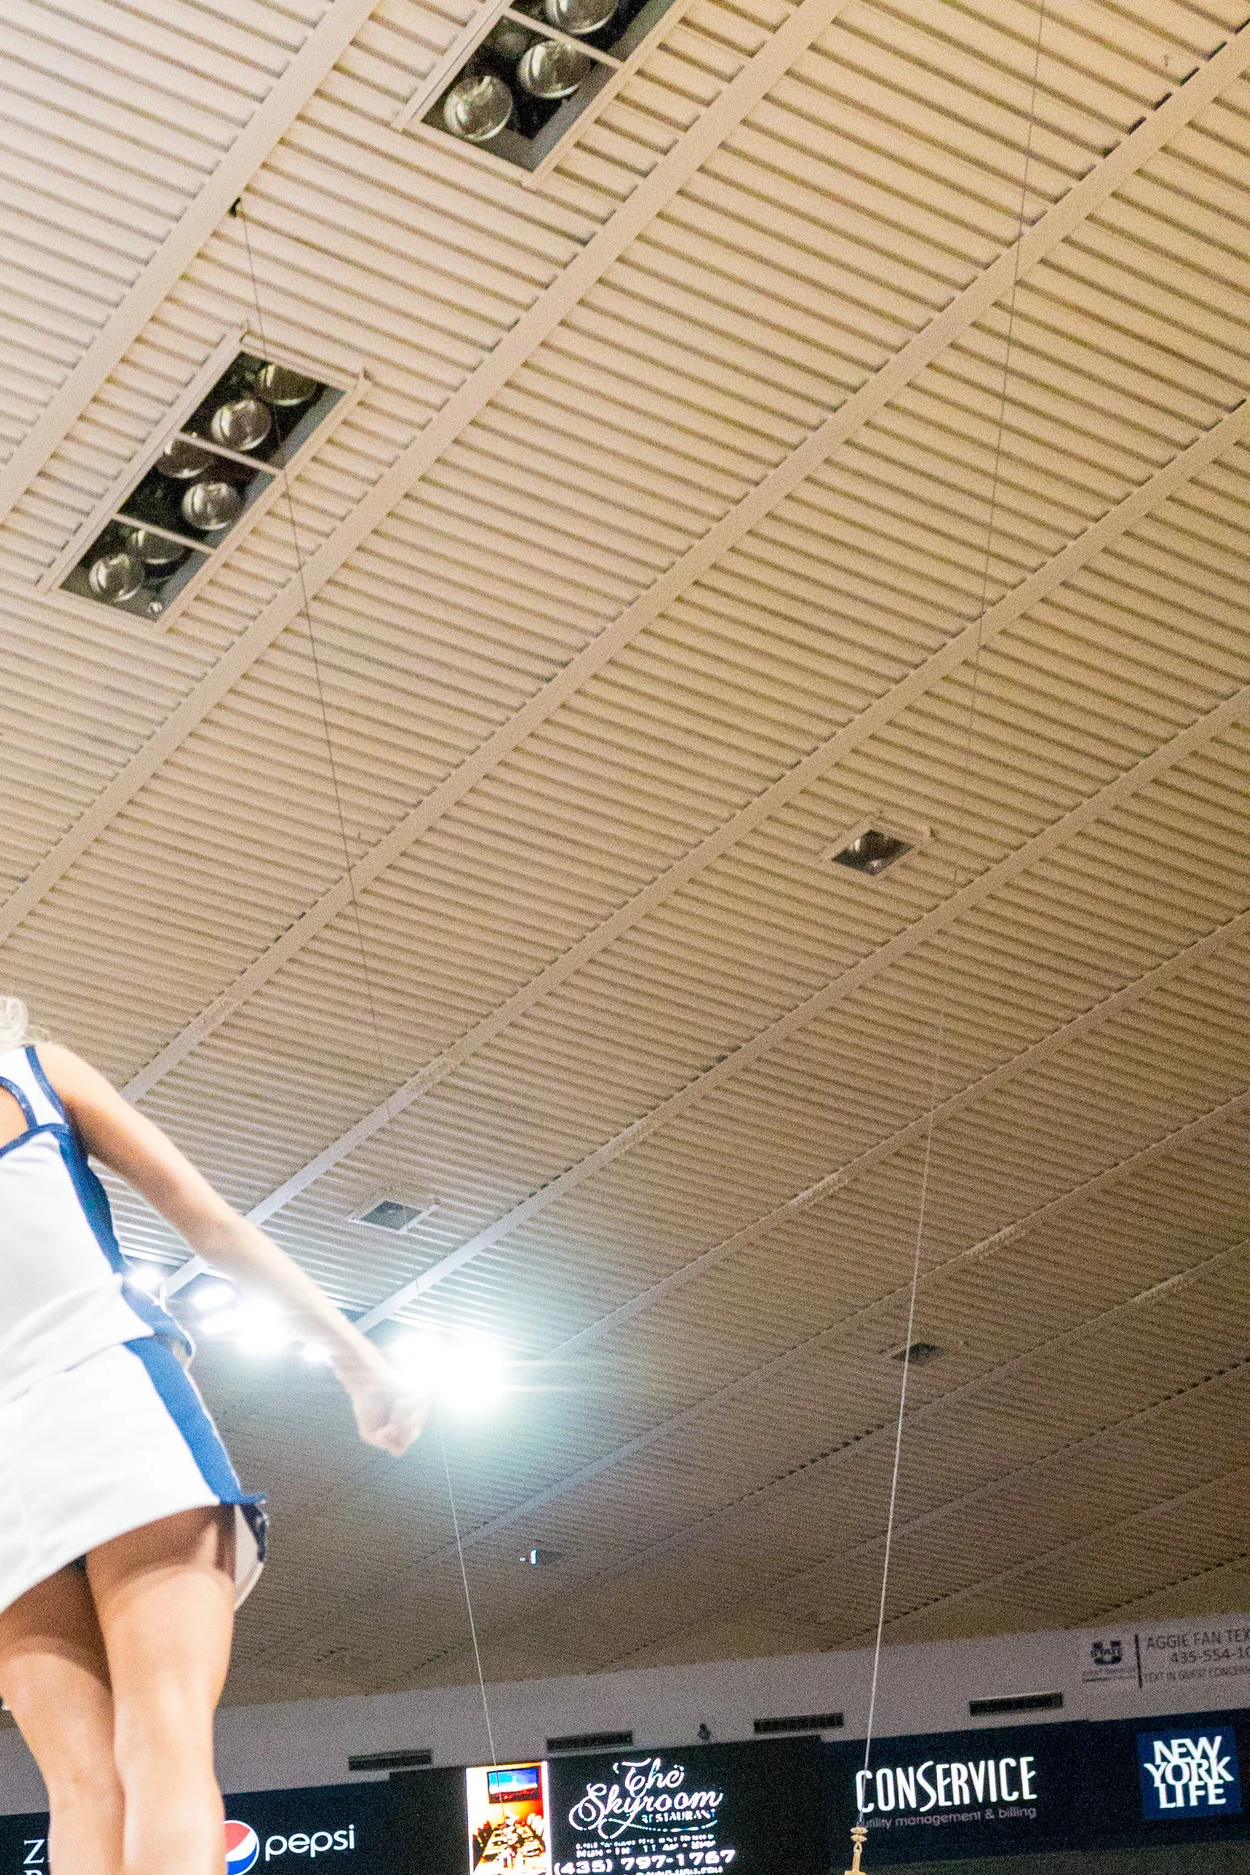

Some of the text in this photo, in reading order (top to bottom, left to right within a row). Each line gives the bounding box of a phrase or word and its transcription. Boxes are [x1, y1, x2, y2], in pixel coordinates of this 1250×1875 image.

[1226, 1628, 1250, 1643] TEX
[1153, 1735, 1222, 1765] NEW
[613, 1757, 686, 1798] The
[1143, 1756, 1235, 1788] YORK
[1158, 1779, 1227, 1809] LIFE
[568, 1783, 724, 1840] Skyroom
[895, 1809, 982, 1827] management
[985, 1808, 996, 1820] &
[999, 1806, 1038, 1820] billing
[23, 1838, 50, 1865] Z
[265, 1824, 356, 1862] pepsi
[620, 1849, 737, 1871] 797-1767
